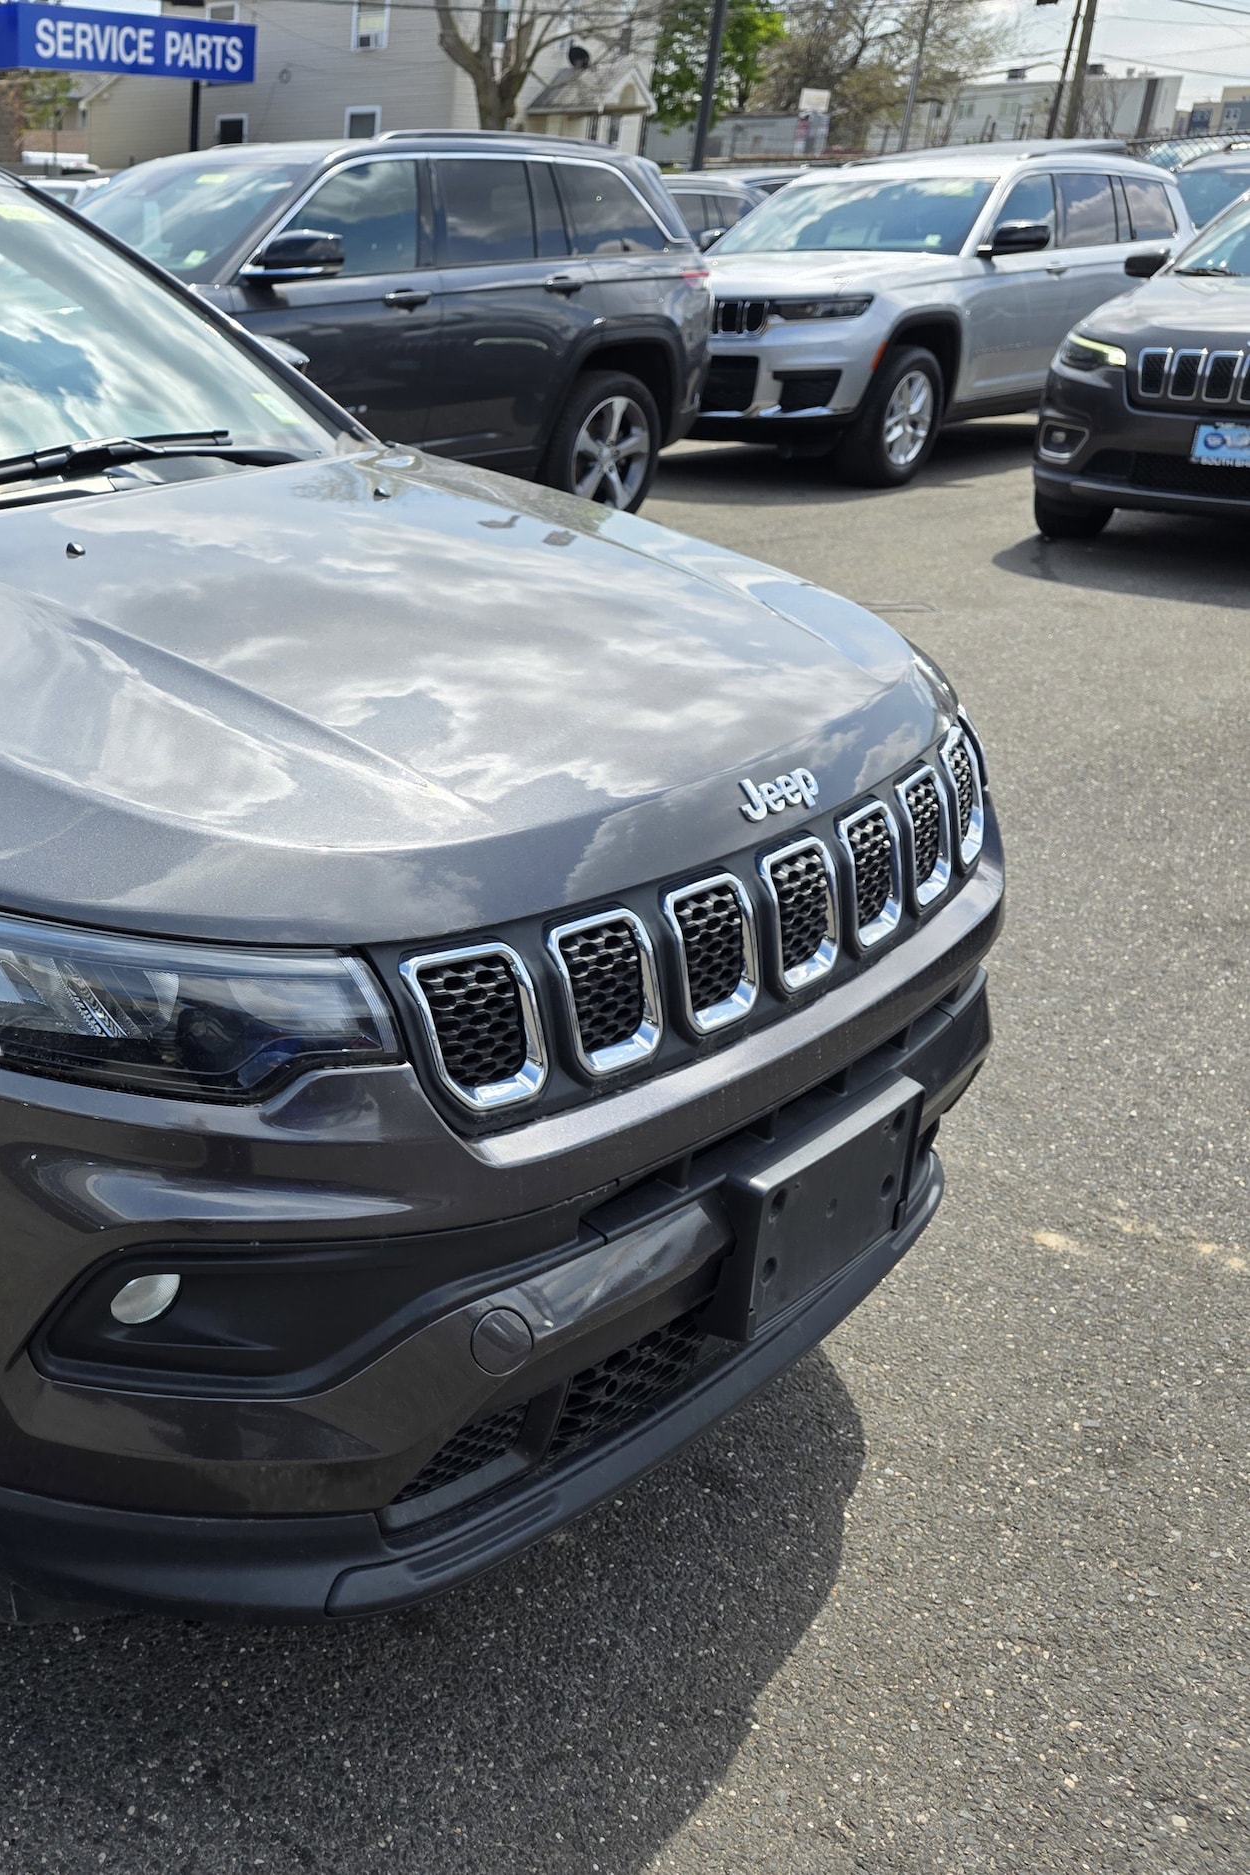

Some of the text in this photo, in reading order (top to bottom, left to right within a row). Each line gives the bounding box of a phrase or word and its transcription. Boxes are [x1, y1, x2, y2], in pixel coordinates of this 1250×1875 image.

[35, 18, 243, 73] SERVICE PARTS
[737, 767, 819, 822] Jeep
